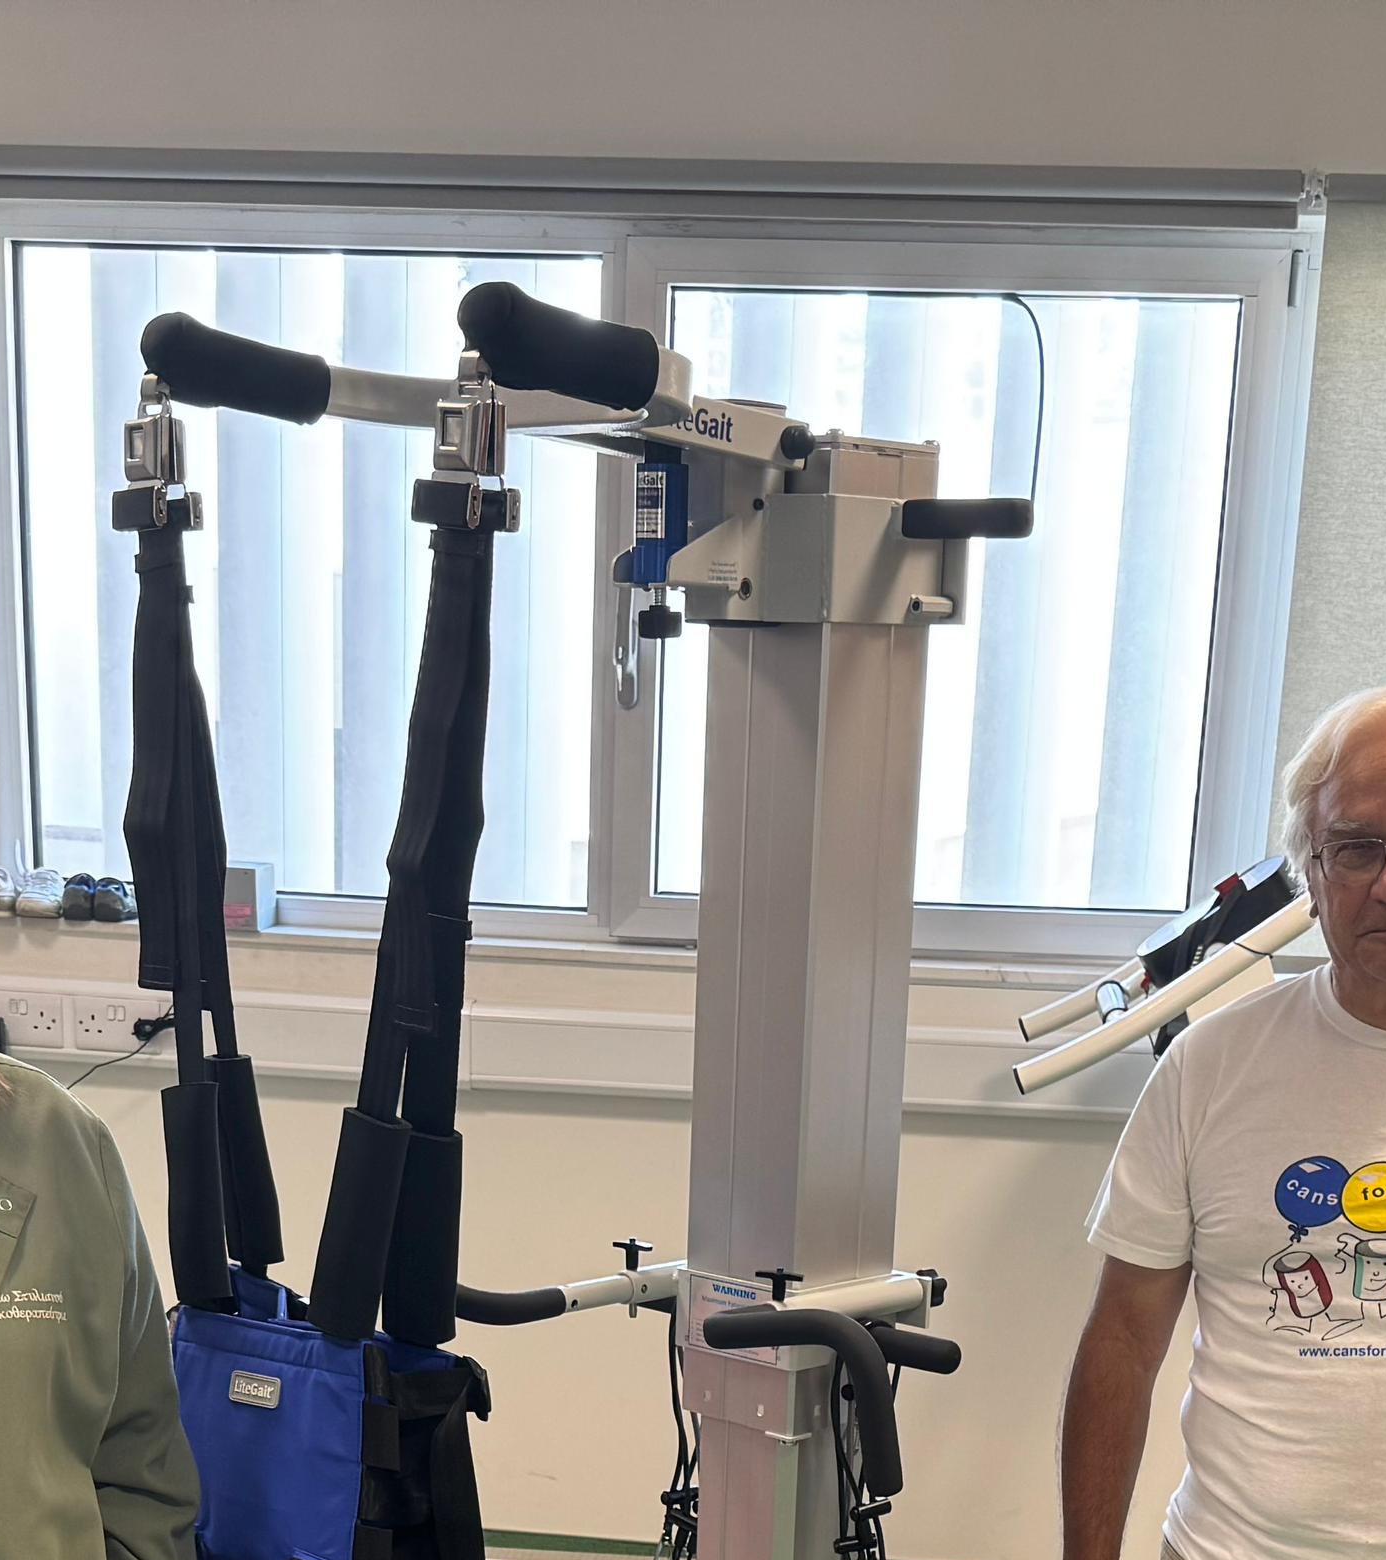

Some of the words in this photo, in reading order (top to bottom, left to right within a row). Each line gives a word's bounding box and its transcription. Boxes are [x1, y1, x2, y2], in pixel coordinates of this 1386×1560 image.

[1286, 1179, 1339, 1205] cans
[713, 1284, 757, 1300] WARNING
[234, 1379, 274, 1399] LiteGait
